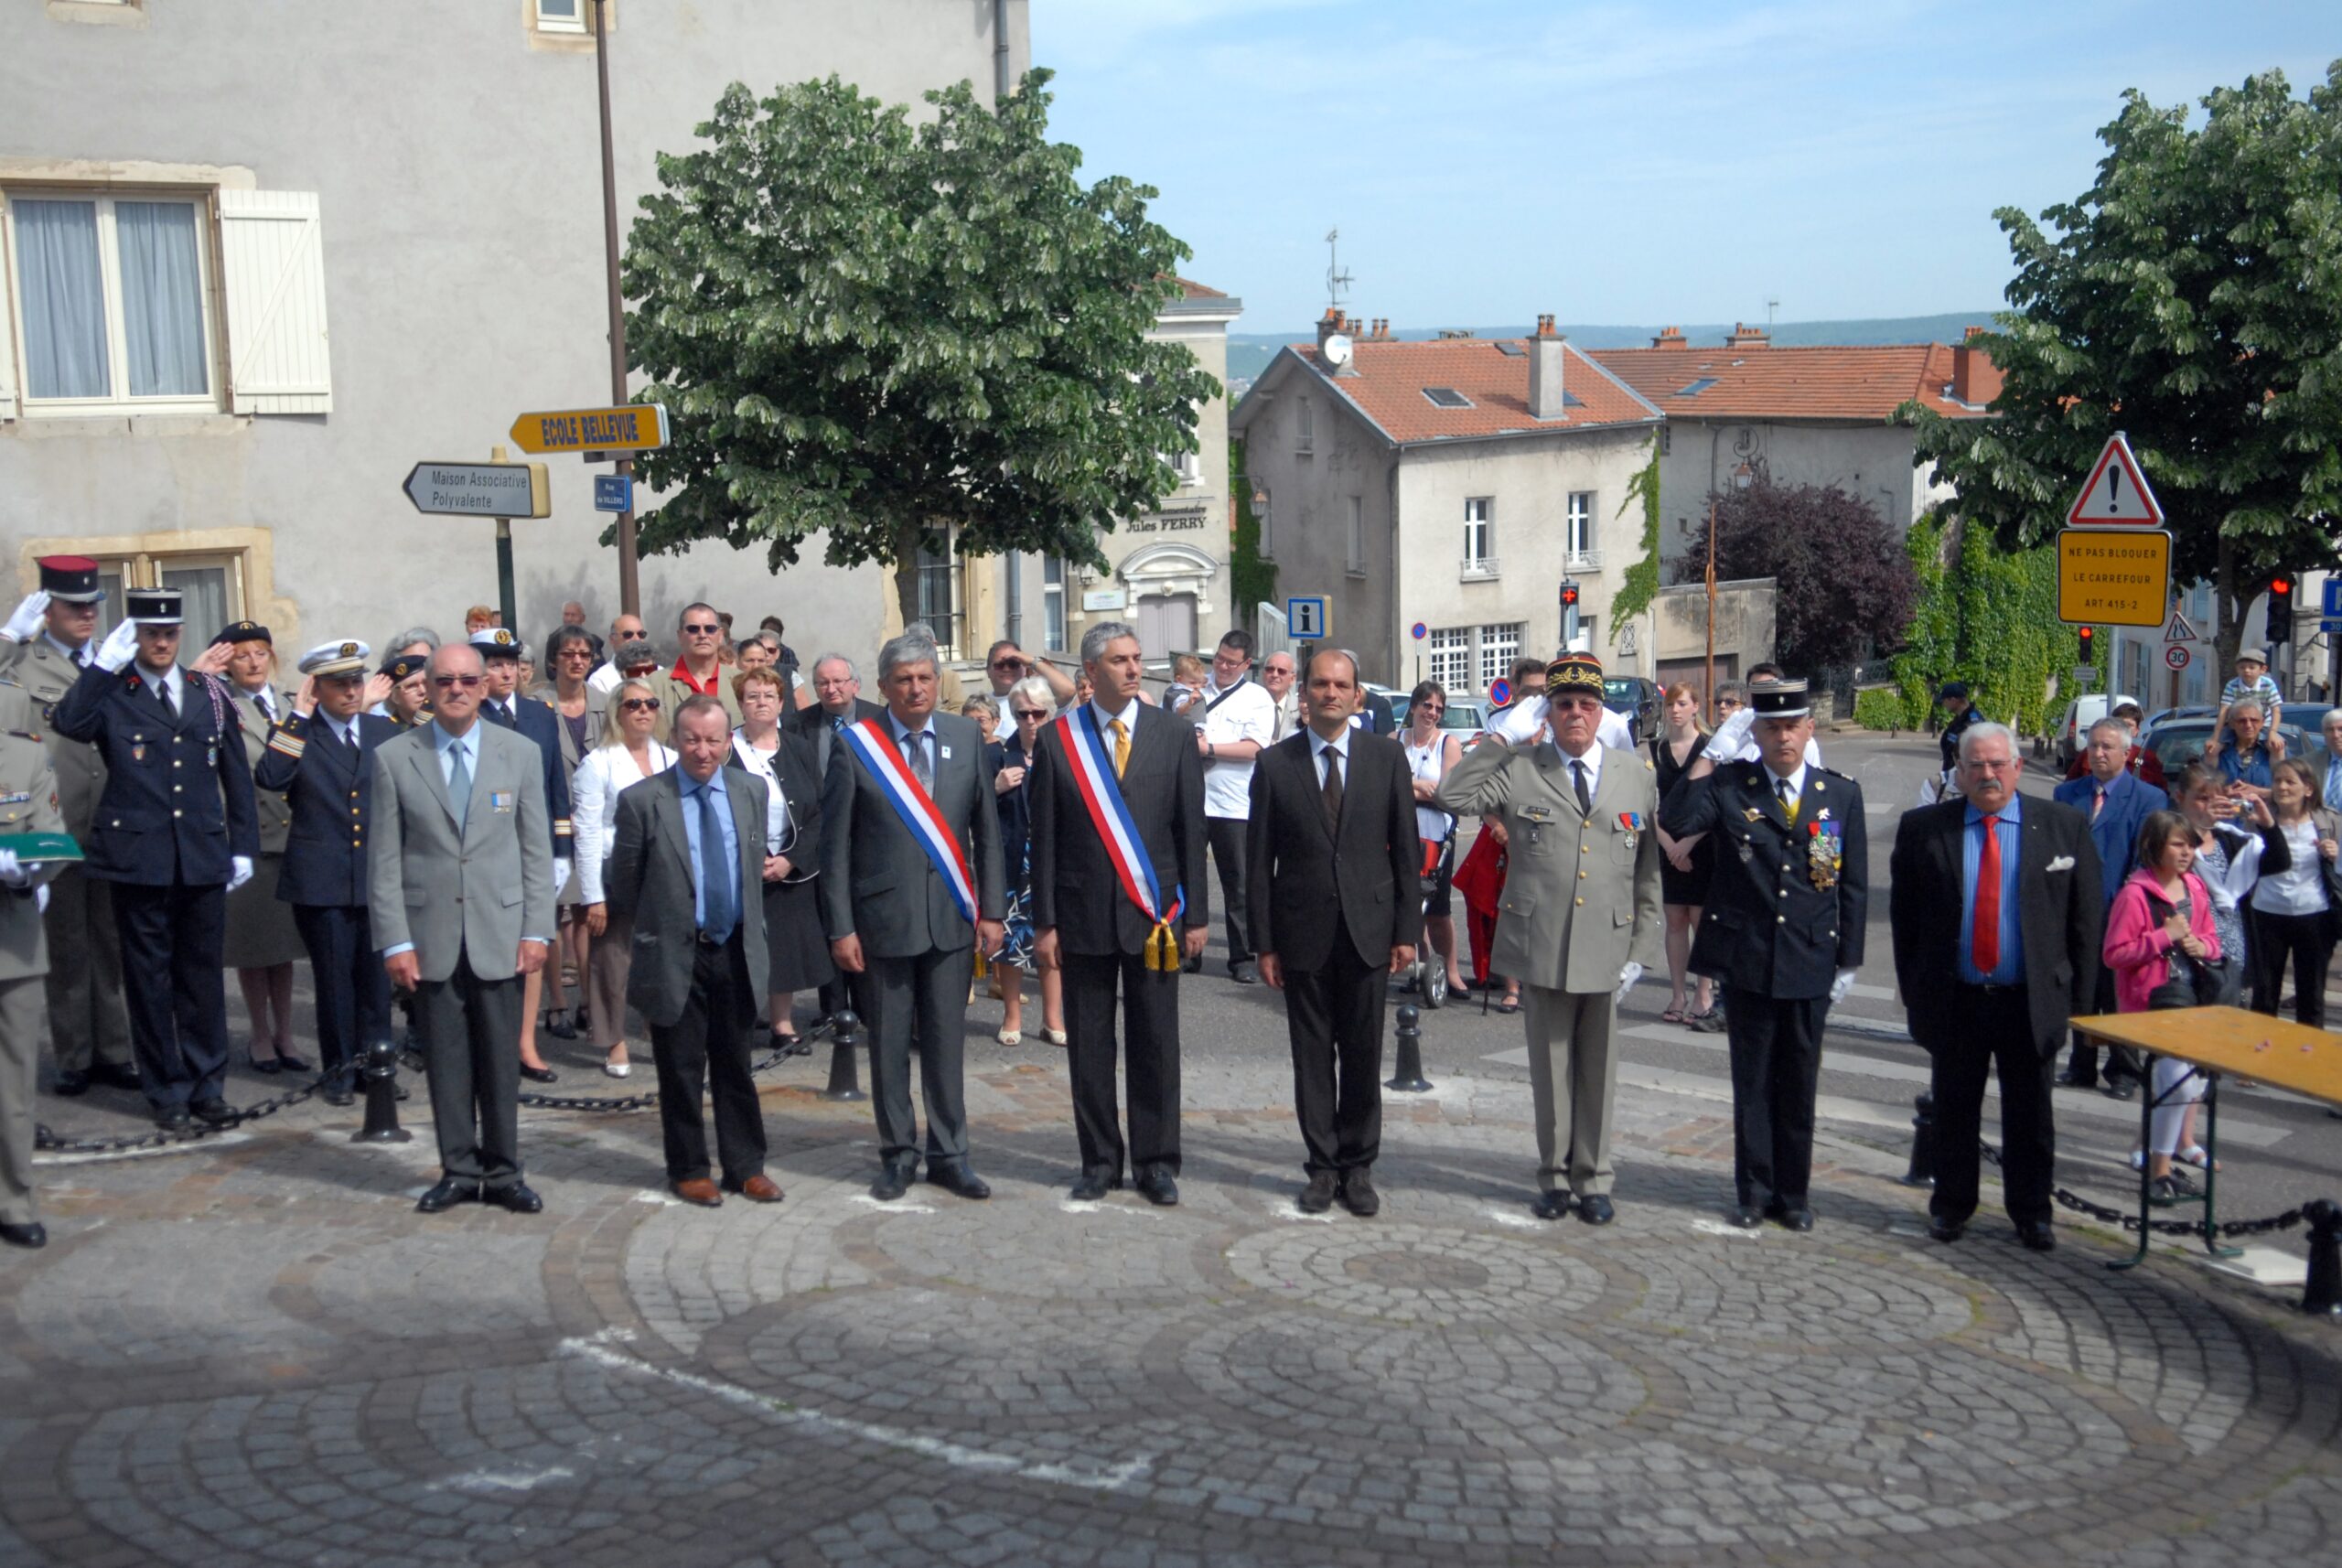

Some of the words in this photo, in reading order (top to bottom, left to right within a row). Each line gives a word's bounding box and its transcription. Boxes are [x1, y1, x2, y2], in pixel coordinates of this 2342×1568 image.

[541, 416, 579, 446] ECOLE
[581, 412, 639, 445] BELLEVUE
[432, 470, 466, 487] Maison
[469, 471, 527, 489] Associative
[432, 491, 492, 509] Polyvalente
[1125, 520, 1156, 533] Jules
[1161, 517, 1207, 532] FERRY
[2068, 548, 2083, 557] NE
[2085, 548, 2105, 558] PAS
[2108, 548, 2157, 558] BLOQUER
[2073, 573, 2085, 583] LE
[2088, 574, 2152, 585] CARREFOUR
[2085, 598, 2104, 608] ART
[2107, 599, 2138, 610] 415-2
[2171, 652, 2186, 663] 30
